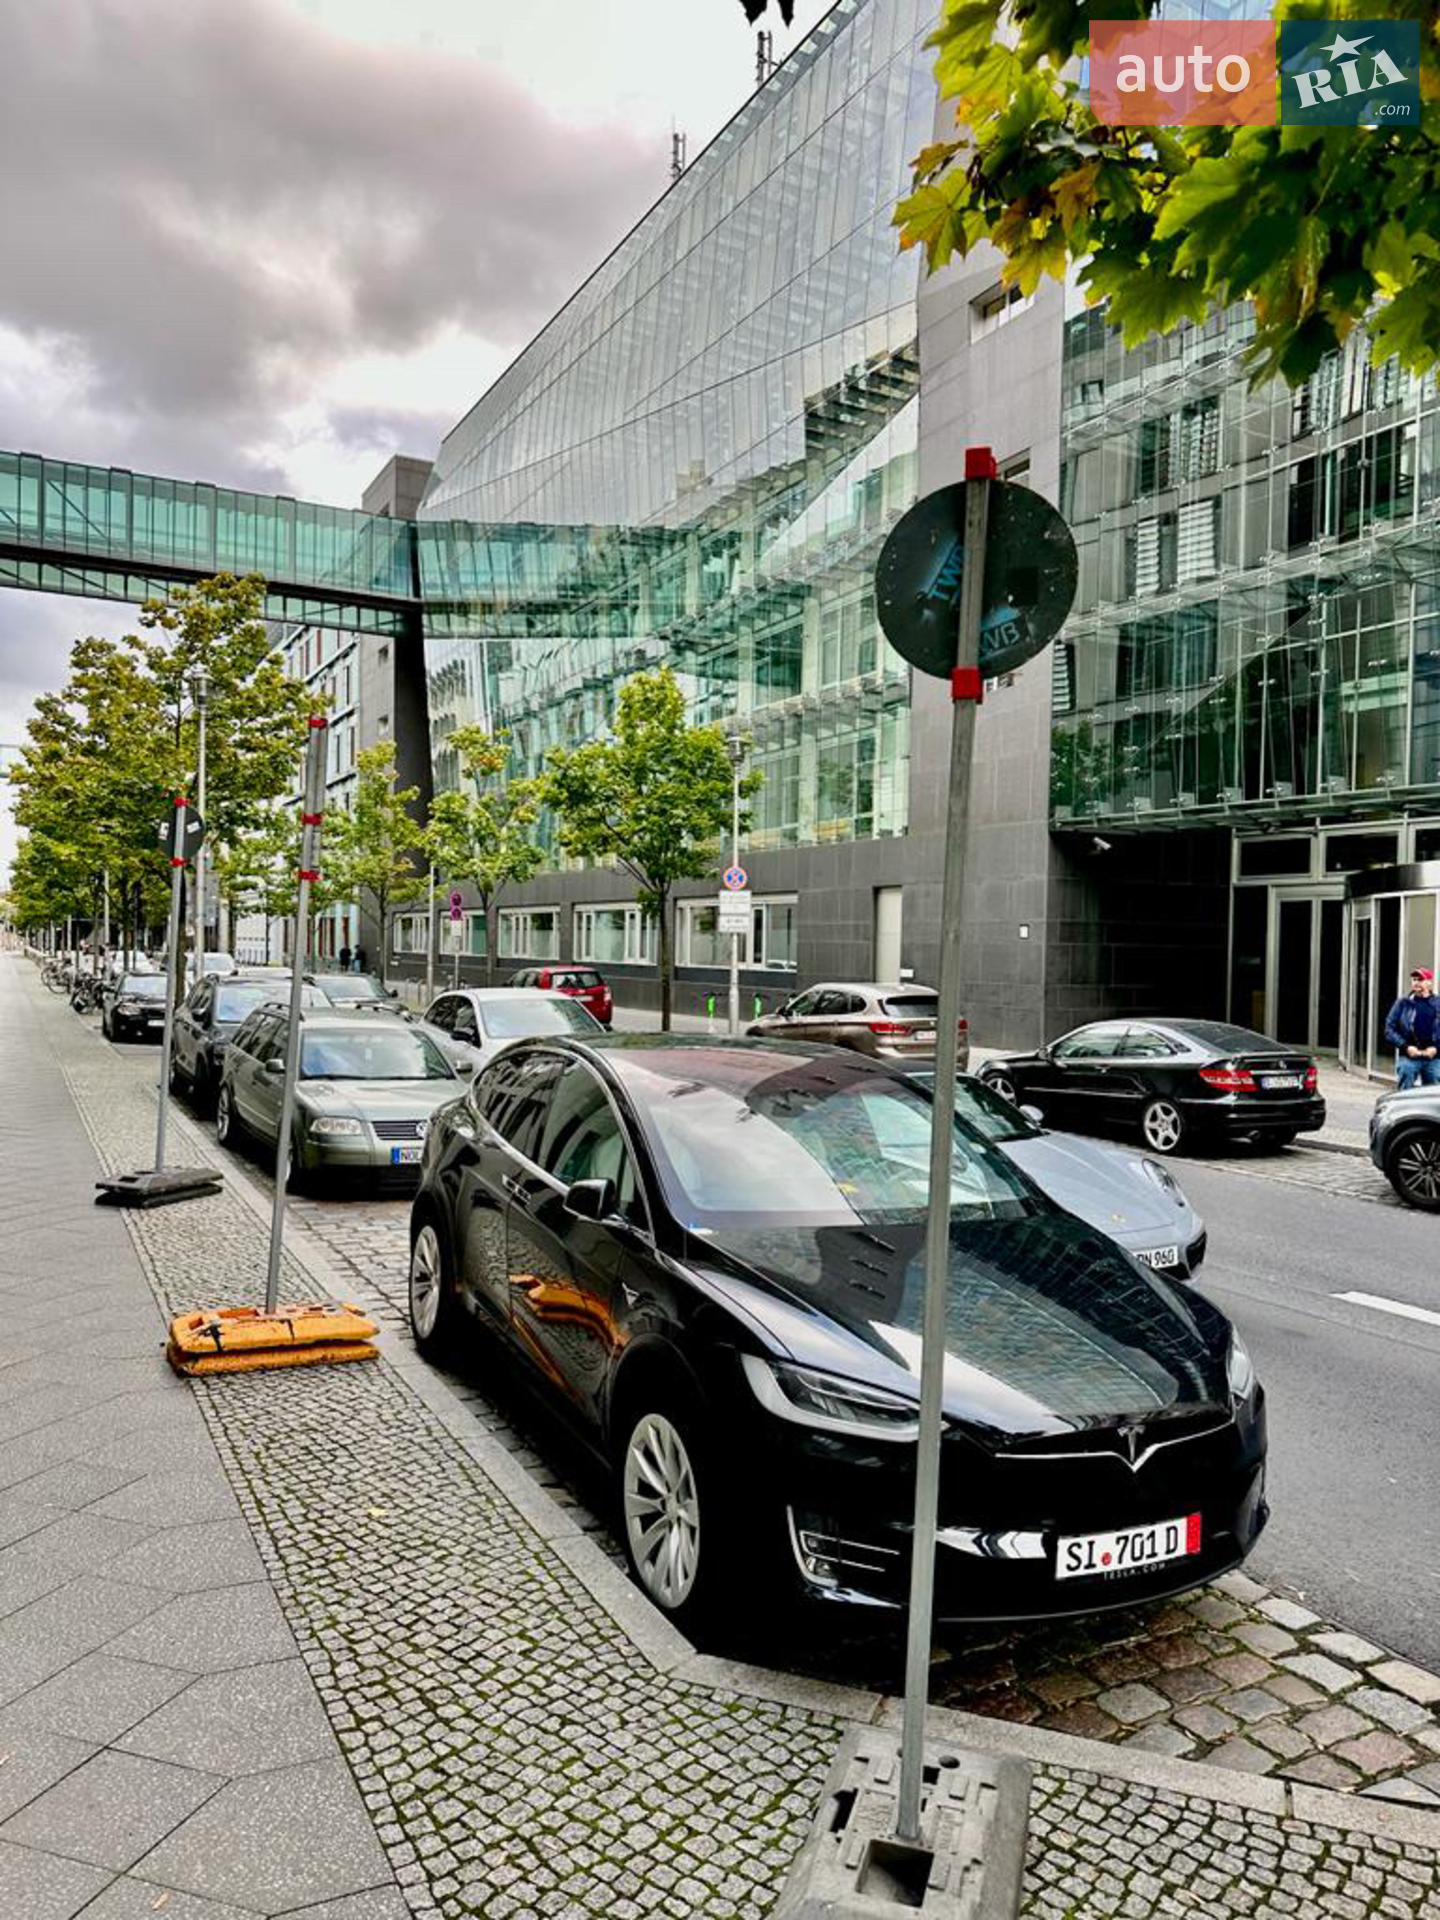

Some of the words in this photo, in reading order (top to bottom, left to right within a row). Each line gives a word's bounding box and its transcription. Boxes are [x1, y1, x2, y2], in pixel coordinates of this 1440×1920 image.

[1154, 1249, 1174, 1265] 960
[1066, 1540, 1096, 1572] SI
[1115, 1530, 1158, 1564] 701
[1165, 1525, 1179, 1555] D
